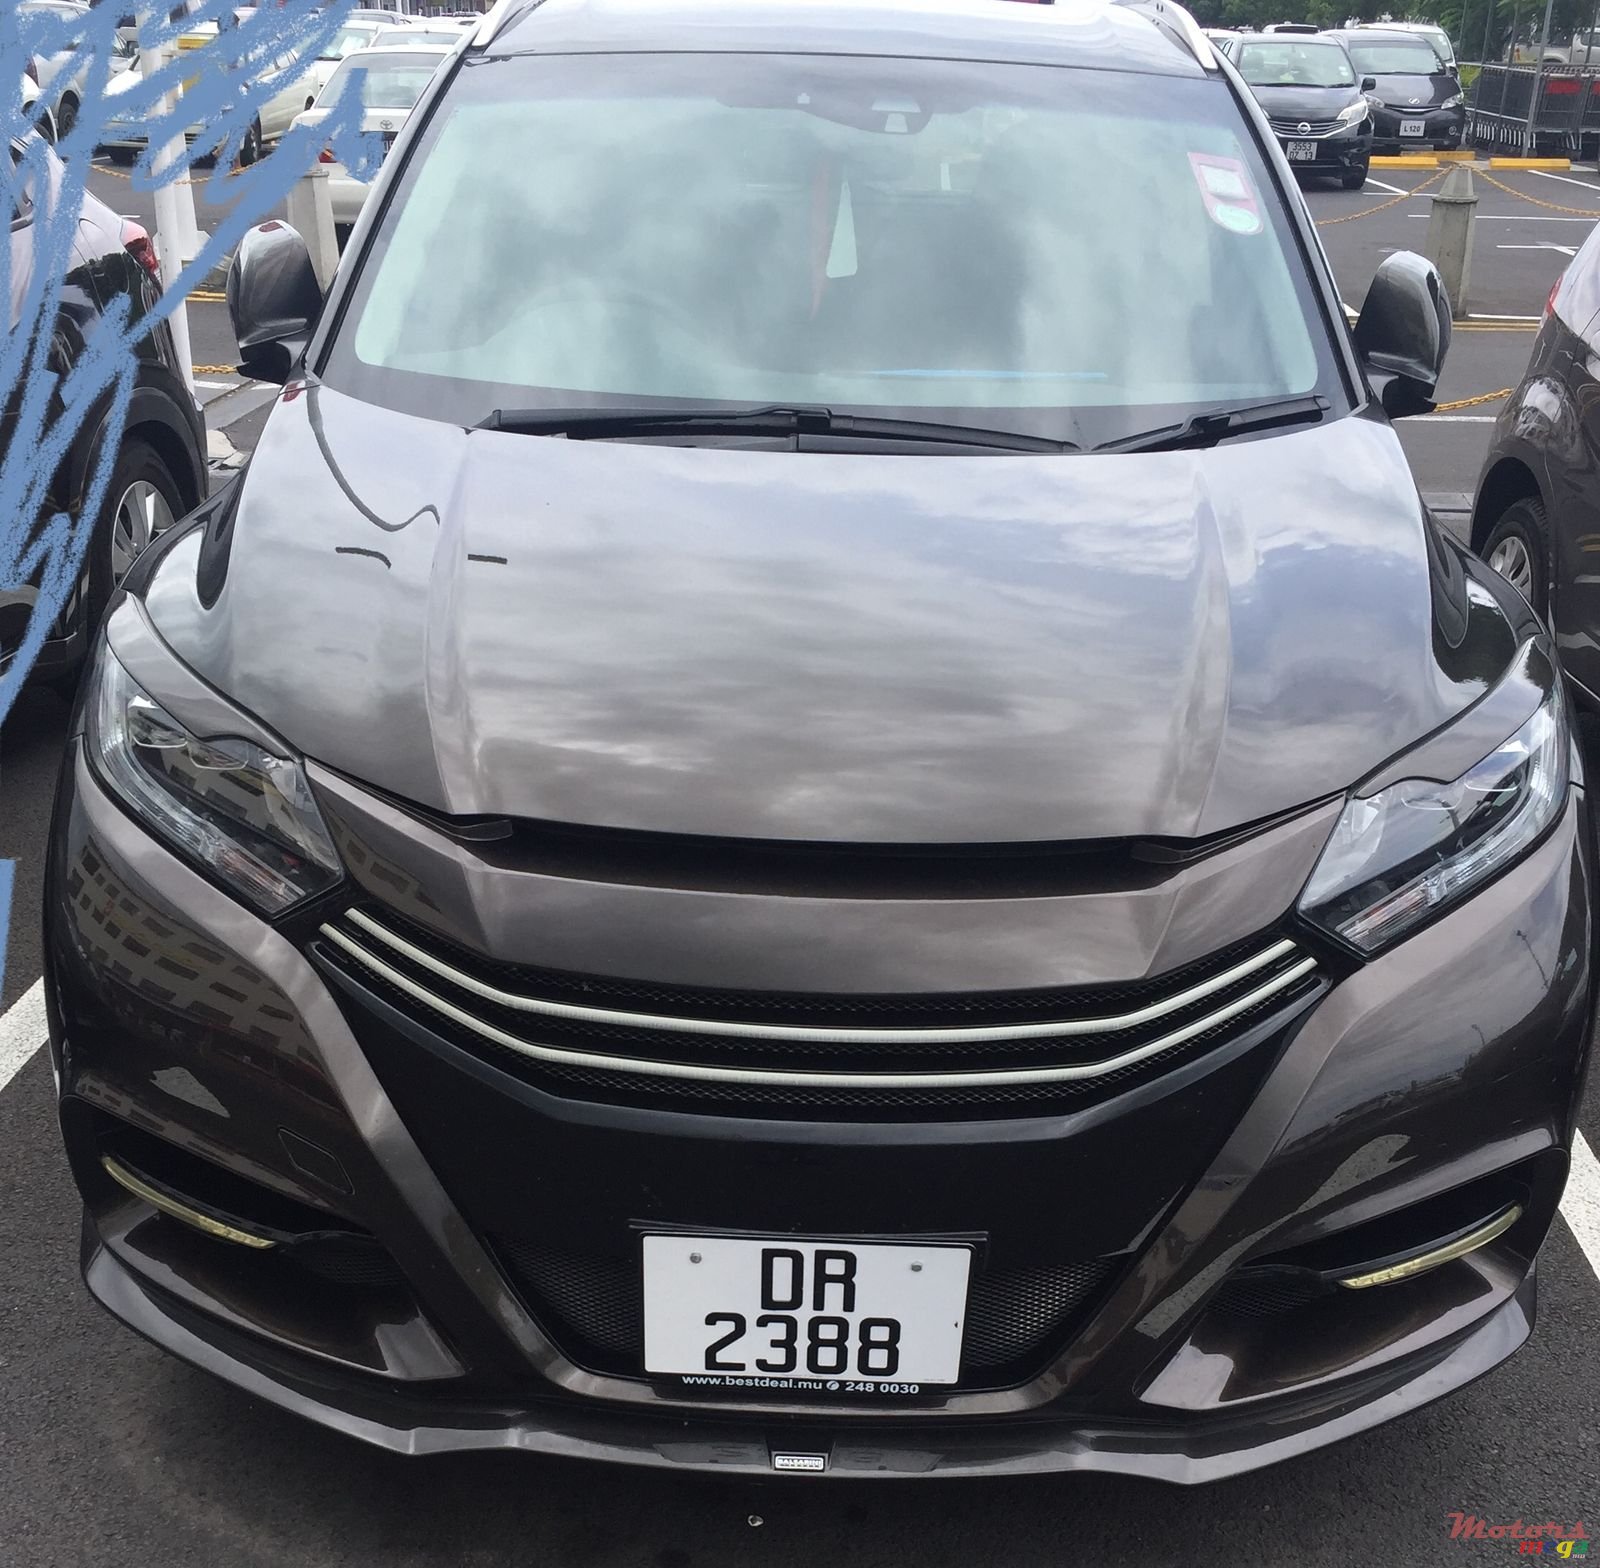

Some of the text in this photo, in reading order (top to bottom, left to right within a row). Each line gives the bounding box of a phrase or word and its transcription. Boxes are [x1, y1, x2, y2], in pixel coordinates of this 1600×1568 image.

[761, 1248, 857, 1312] DR
[704, 1312, 901, 1376] 2388
[682, 1376, 919, 1394] www.bestdeal.mu 248 0030
